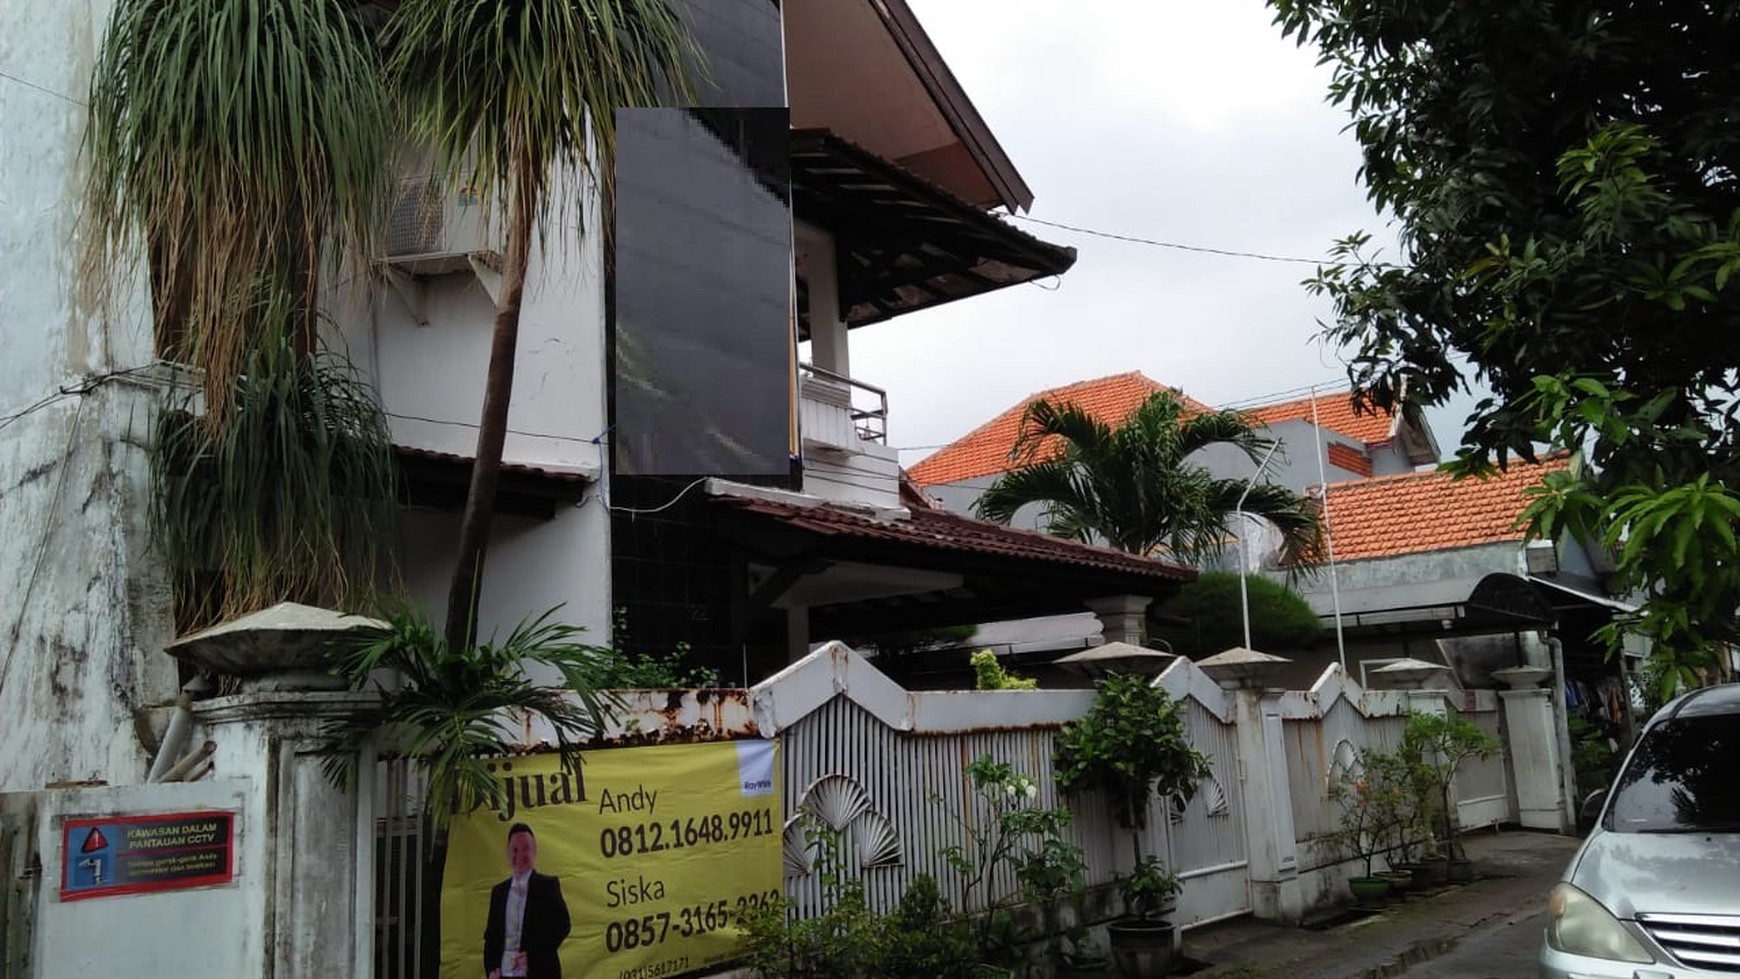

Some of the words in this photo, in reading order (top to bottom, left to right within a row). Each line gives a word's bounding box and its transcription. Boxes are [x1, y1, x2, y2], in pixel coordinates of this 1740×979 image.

[599, 785, 657, 815] Andy
[128, 828, 179, 839] KAWASAN
[183, 824, 217, 834] DALAM
[129, 837, 186, 849] PANTAUAN
[188, 834, 215, 843] CCTV
[601, 808, 773, 858] 0812.1648.9911
[606, 875, 665, 907] Siska
